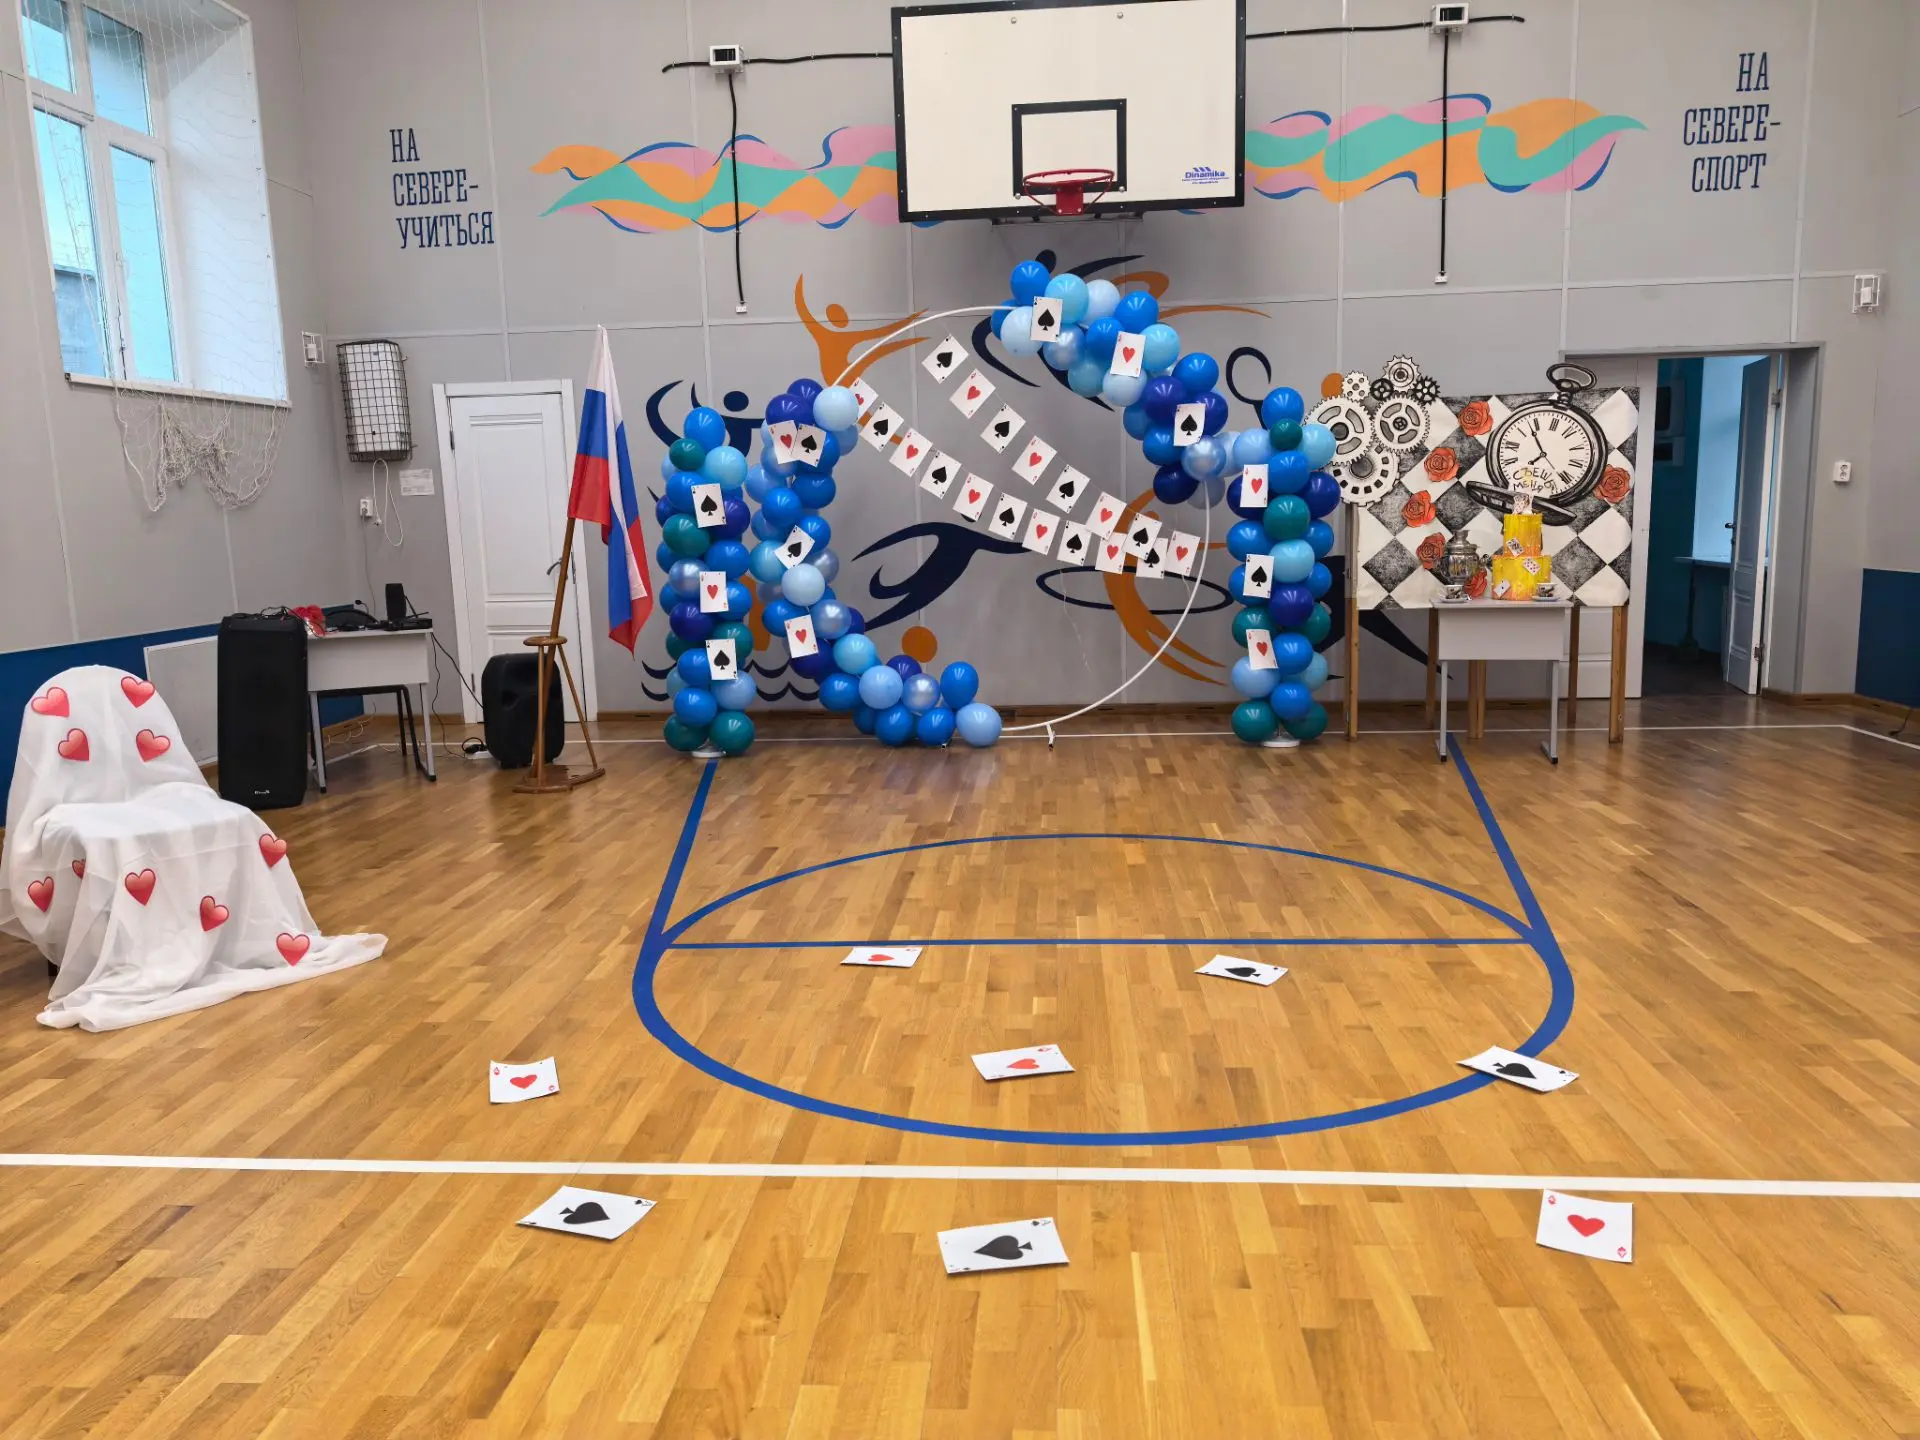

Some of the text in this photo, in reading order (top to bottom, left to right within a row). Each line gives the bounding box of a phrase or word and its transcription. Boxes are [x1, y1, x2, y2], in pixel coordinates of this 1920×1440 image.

[1735, 51, 1770, 92] НА
[1683, 103, 1781, 146] СЕВЕРЕ-
[389, 128, 420, 163] НА
[392, 168, 479, 207] СЕВЕРЕ-
[1185, 170, 1226, 179] Dinamika
[1691, 153, 1767, 193] СПОРТ
[396, 211, 495, 249] УЧИТЬСЯ
